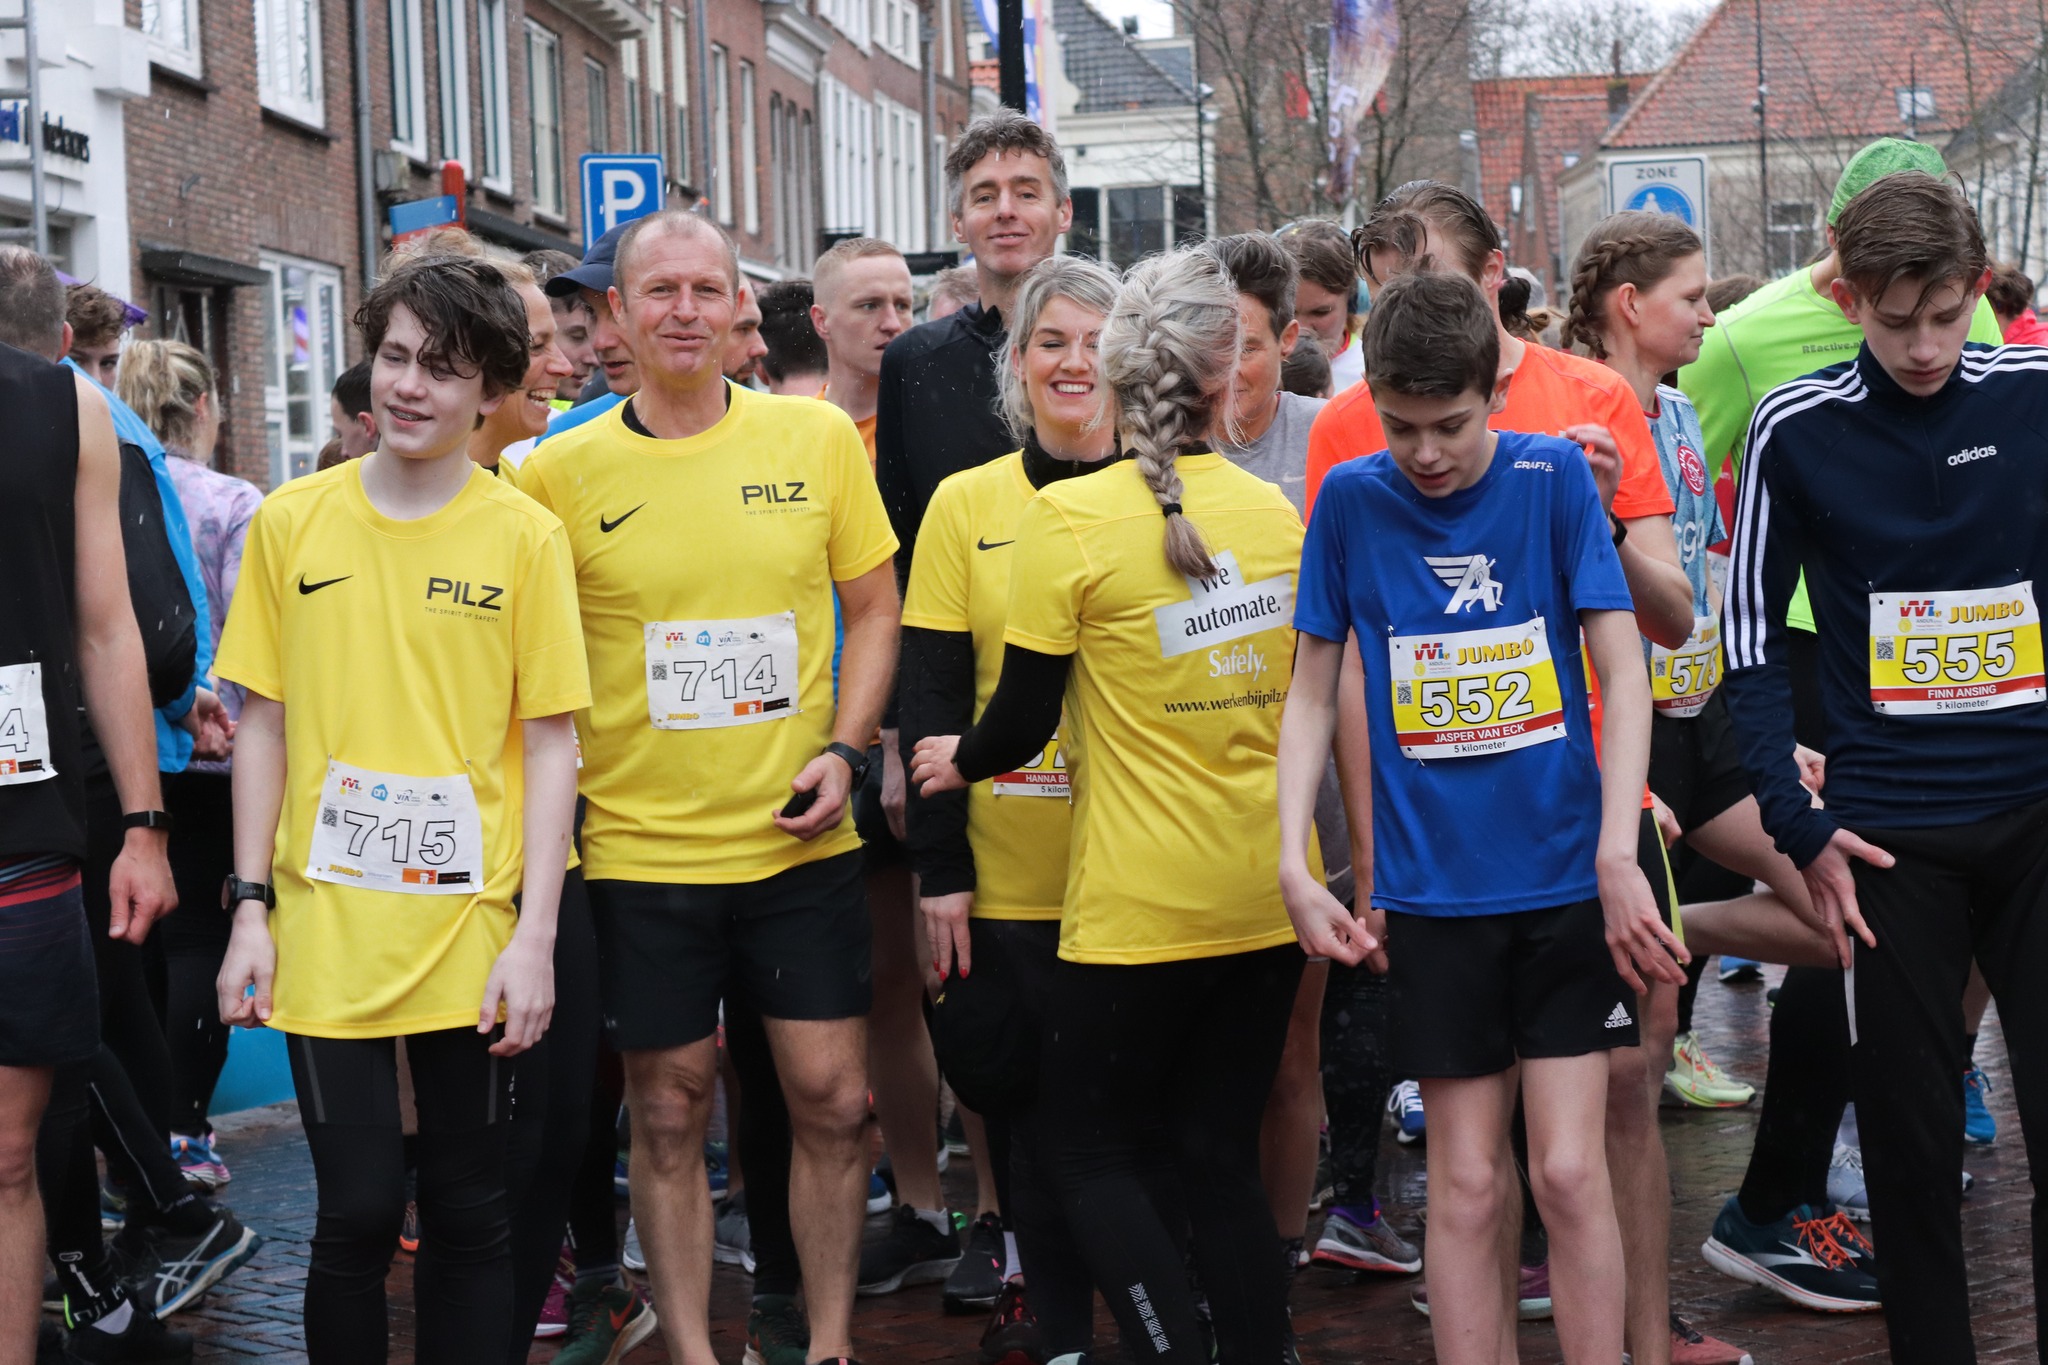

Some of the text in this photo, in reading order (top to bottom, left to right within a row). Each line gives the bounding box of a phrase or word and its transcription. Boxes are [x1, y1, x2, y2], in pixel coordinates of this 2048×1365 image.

[1636, 166, 1678, 180] ZONE
[602, 169, 646, 232] P
[1802, 341, 1862, 354] REactive.n
[1513, 461, 1547, 470] CRAFT
[1947, 445, 1998, 466] adidas
[741, 482, 808, 505] PILZ
[426, 576, 504, 611] PILZ
[424, 606, 437, 614] THE
[439, 608, 462, 617] SPIRIT
[474, 614, 499, 623] SAFETY
[1184, 594, 1281, 637] automate.
[1947, 599, 2025, 624] JUMBO
[1456, 637, 1535, 666] JUMBO
[1902, 630, 2016, 684] 555
[1208, 644, 1268, 682] Safely.
[673, 653, 777, 701] 714
[1164, 686, 1290, 713] www.werkenbijpilz.n
[1420, 671, 1534, 727] 552
[1927, 684, 1997, 699] FINN ANSING
[1936, 699, 1989, 710] 5 kilometer
[666, 713, 700, 721] JUMBO
[1434, 723, 1526, 743] JASPER VAN ECK
[1454, 740, 1507, 753] 5 kilometer
[1025, 774, 1057, 783] HANNA
[1041, 785, 1070, 793] 5 kilom
[344, 810, 456, 865] 715
[328, 864, 364, 878] JUMBO
[1604, 1017, 1633, 1029] adidas
